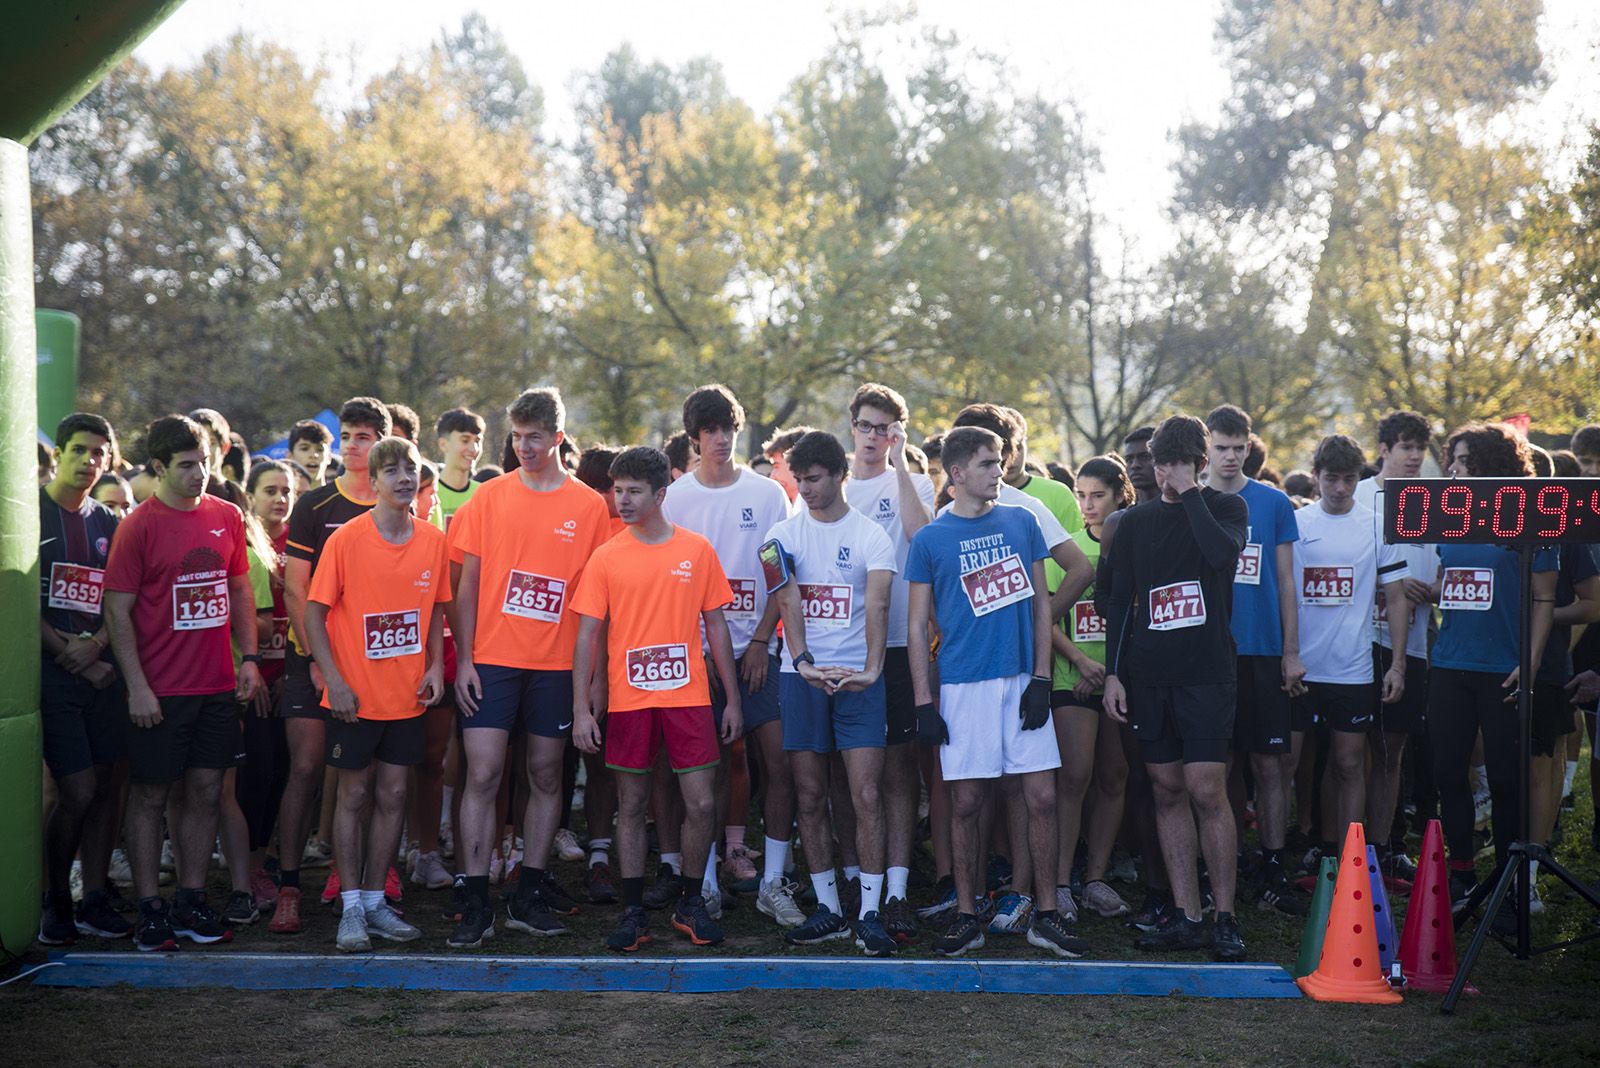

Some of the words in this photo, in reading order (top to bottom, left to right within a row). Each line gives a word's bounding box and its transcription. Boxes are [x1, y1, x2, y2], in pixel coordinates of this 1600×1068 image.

[1397, 486, 1600, 537] 09:09:
[960, 533, 1004, 552] INSTITUT
[959, 545, 1011, 573] ARNAU
[54, 579, 100, 603] 2659
[509, 586, 560, 611] 2657
[974, 572, 1025, 604] 4479
[1305, 580, 1351, 596] 4418
[1444, 583, 1489, 601] 4484
[180, 597, 227, 620] 1263
[722, 593, 753, 610] 96
[800, 599, 847, 618] 4091
[1153, 598, 1199, 622] 4477
[369, 626, 417, 649] 2664
[632, 660, 685, 682] 2660
